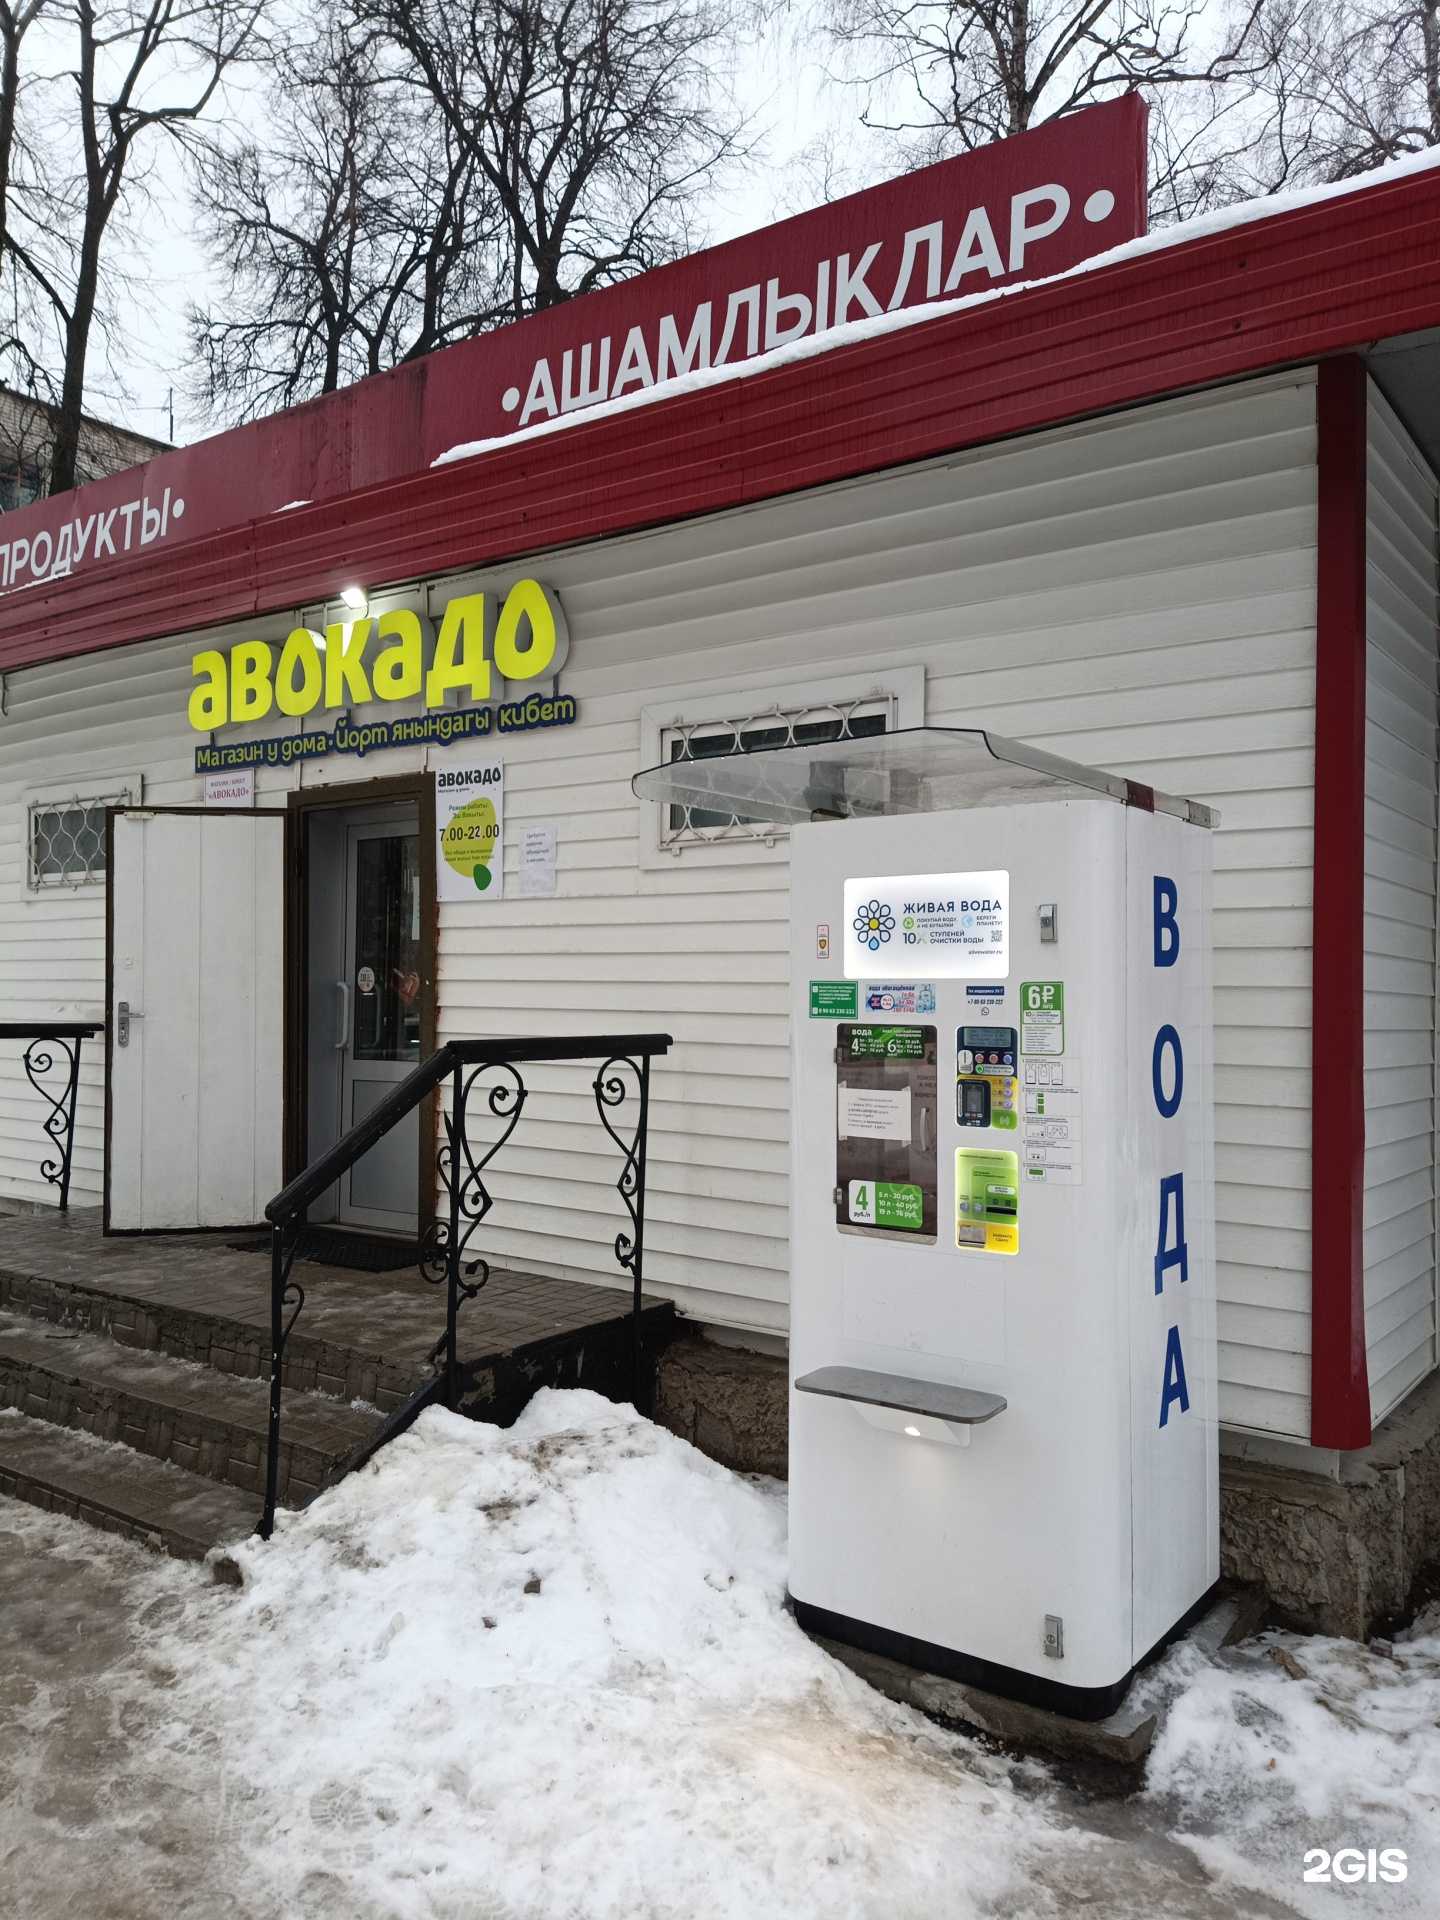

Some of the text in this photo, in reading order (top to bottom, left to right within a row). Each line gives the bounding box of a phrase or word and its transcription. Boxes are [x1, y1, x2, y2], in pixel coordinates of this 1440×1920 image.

[187, 578, 557, 731] авокадо
[336, 697, 574, 751] Йорт янындагы кибет
[197, 736, 327, 768] Магазин у дома
[438, 767, 502, 787] авокадо
[903, 899, 1002, 914] ЖИВАЯ ВОДА
[902, 932, 917, 944] 10
[929, 930, 965, 938] СТУПЕНЕЙ
[963, 936, 985, 944] ВОДЫ
[851, 1028, 872, 1037] вода
[851, 1037, 859, 1052] 4
[887, 1038, 897, 1053] 6
[1152, 875, 1189, 1430] ВОДА
[855, 1184, 869, 1211] 4
